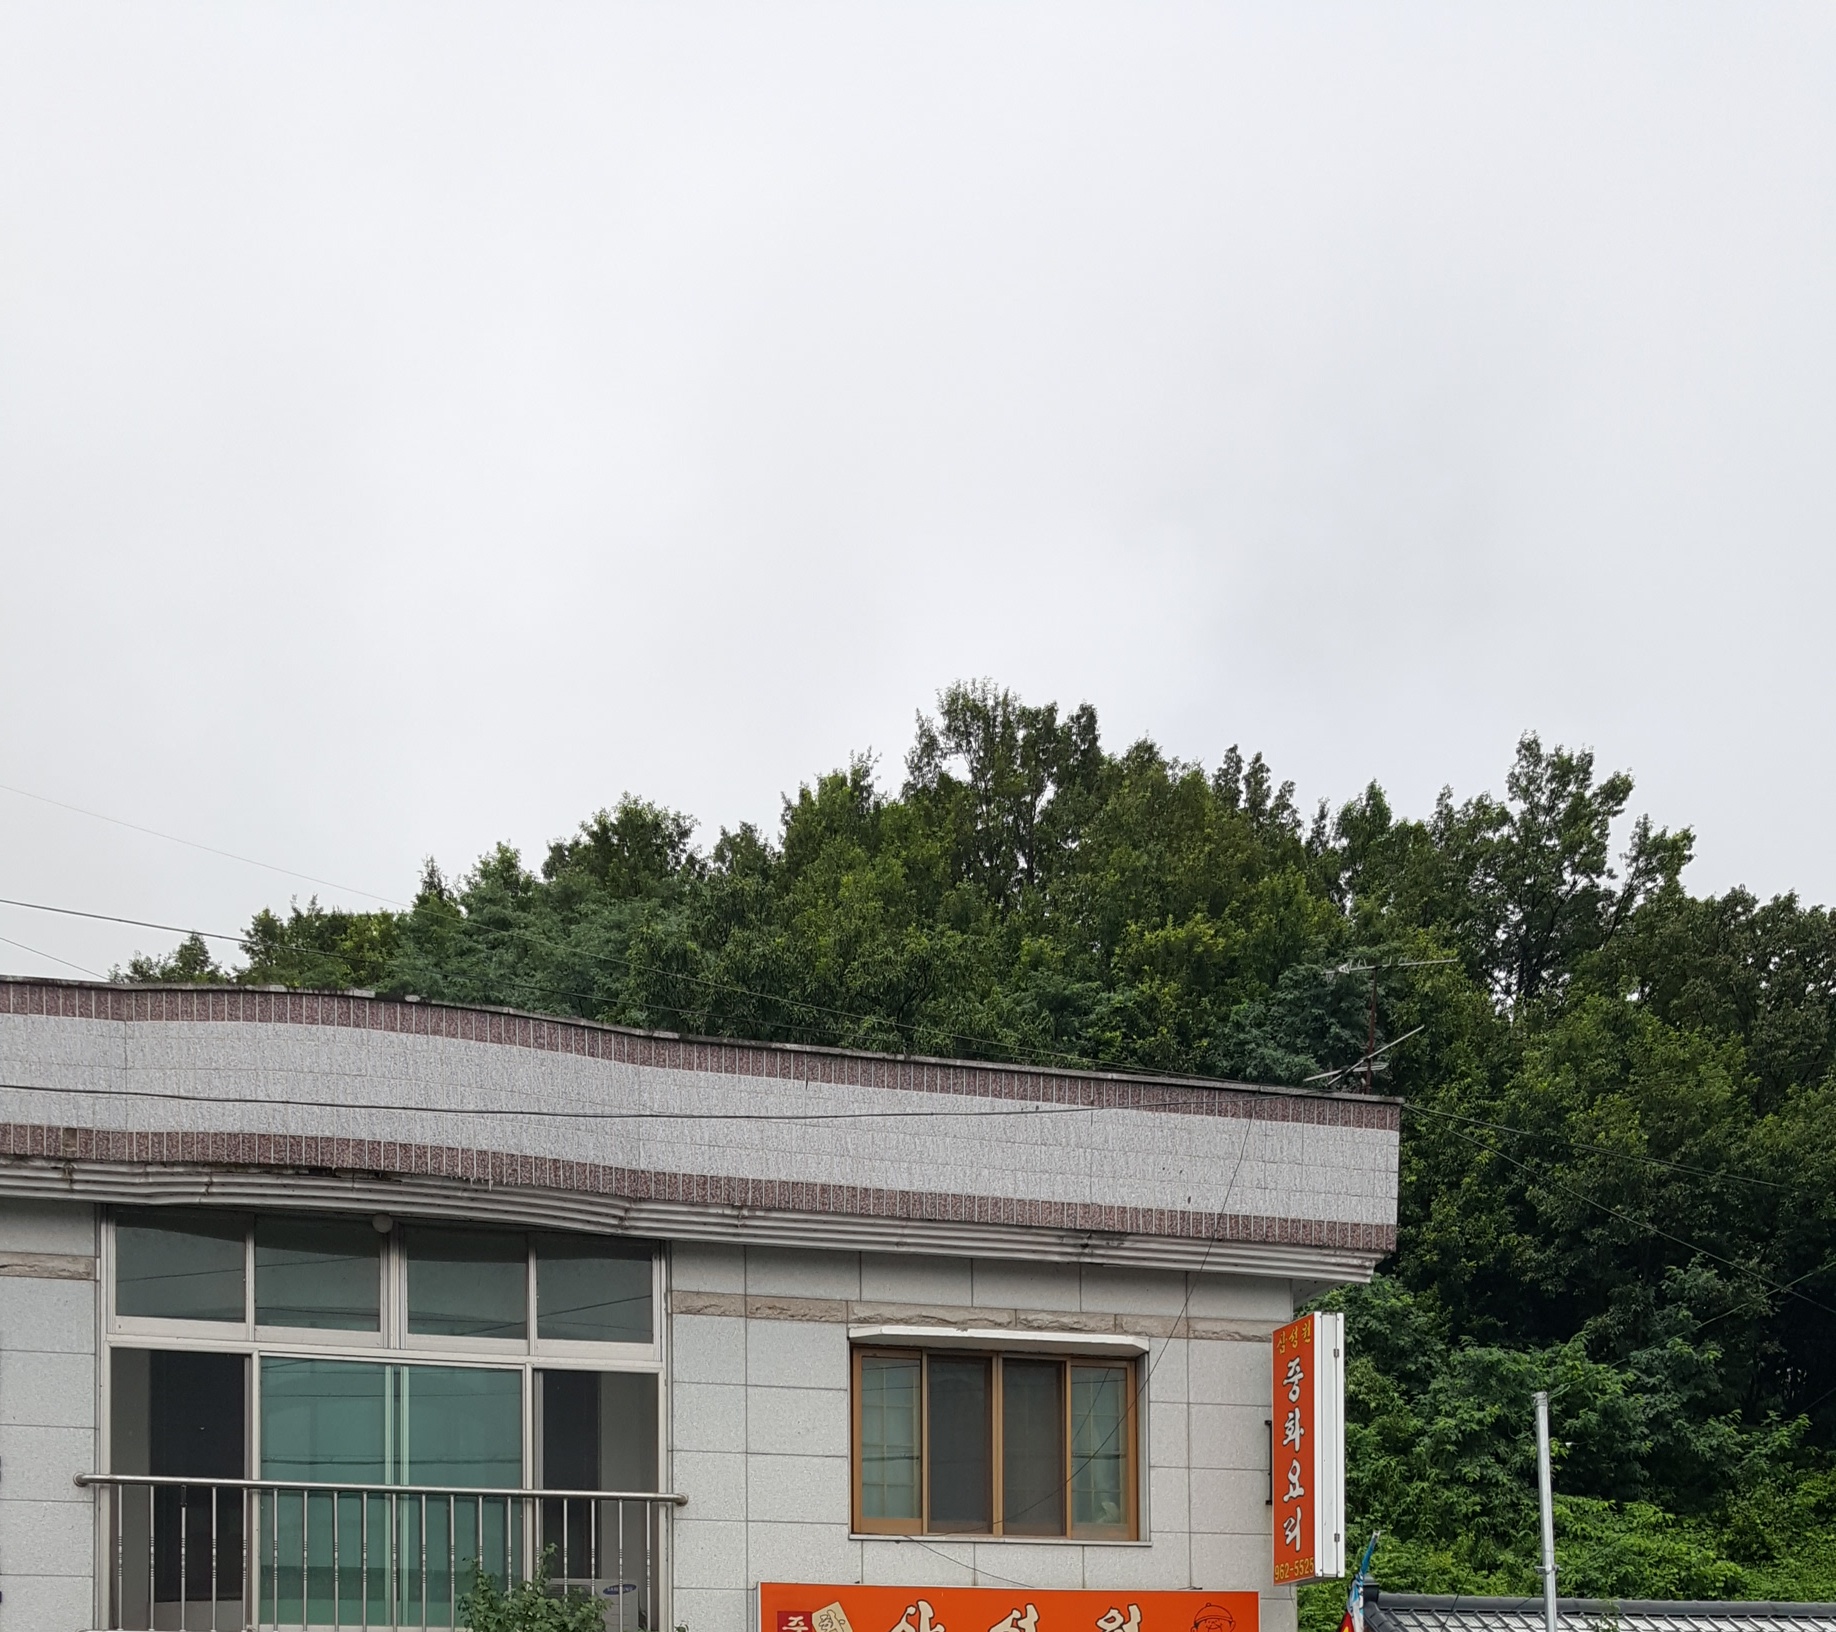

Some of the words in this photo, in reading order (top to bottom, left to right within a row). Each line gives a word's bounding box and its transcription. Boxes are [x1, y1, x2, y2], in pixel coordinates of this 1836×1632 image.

[1276, 1317, 1311, 1355] 삼성원
[1282, 1356, 1305, 1553] 중화요리
[1274, 1556, 1314, 1581] 962-5525
